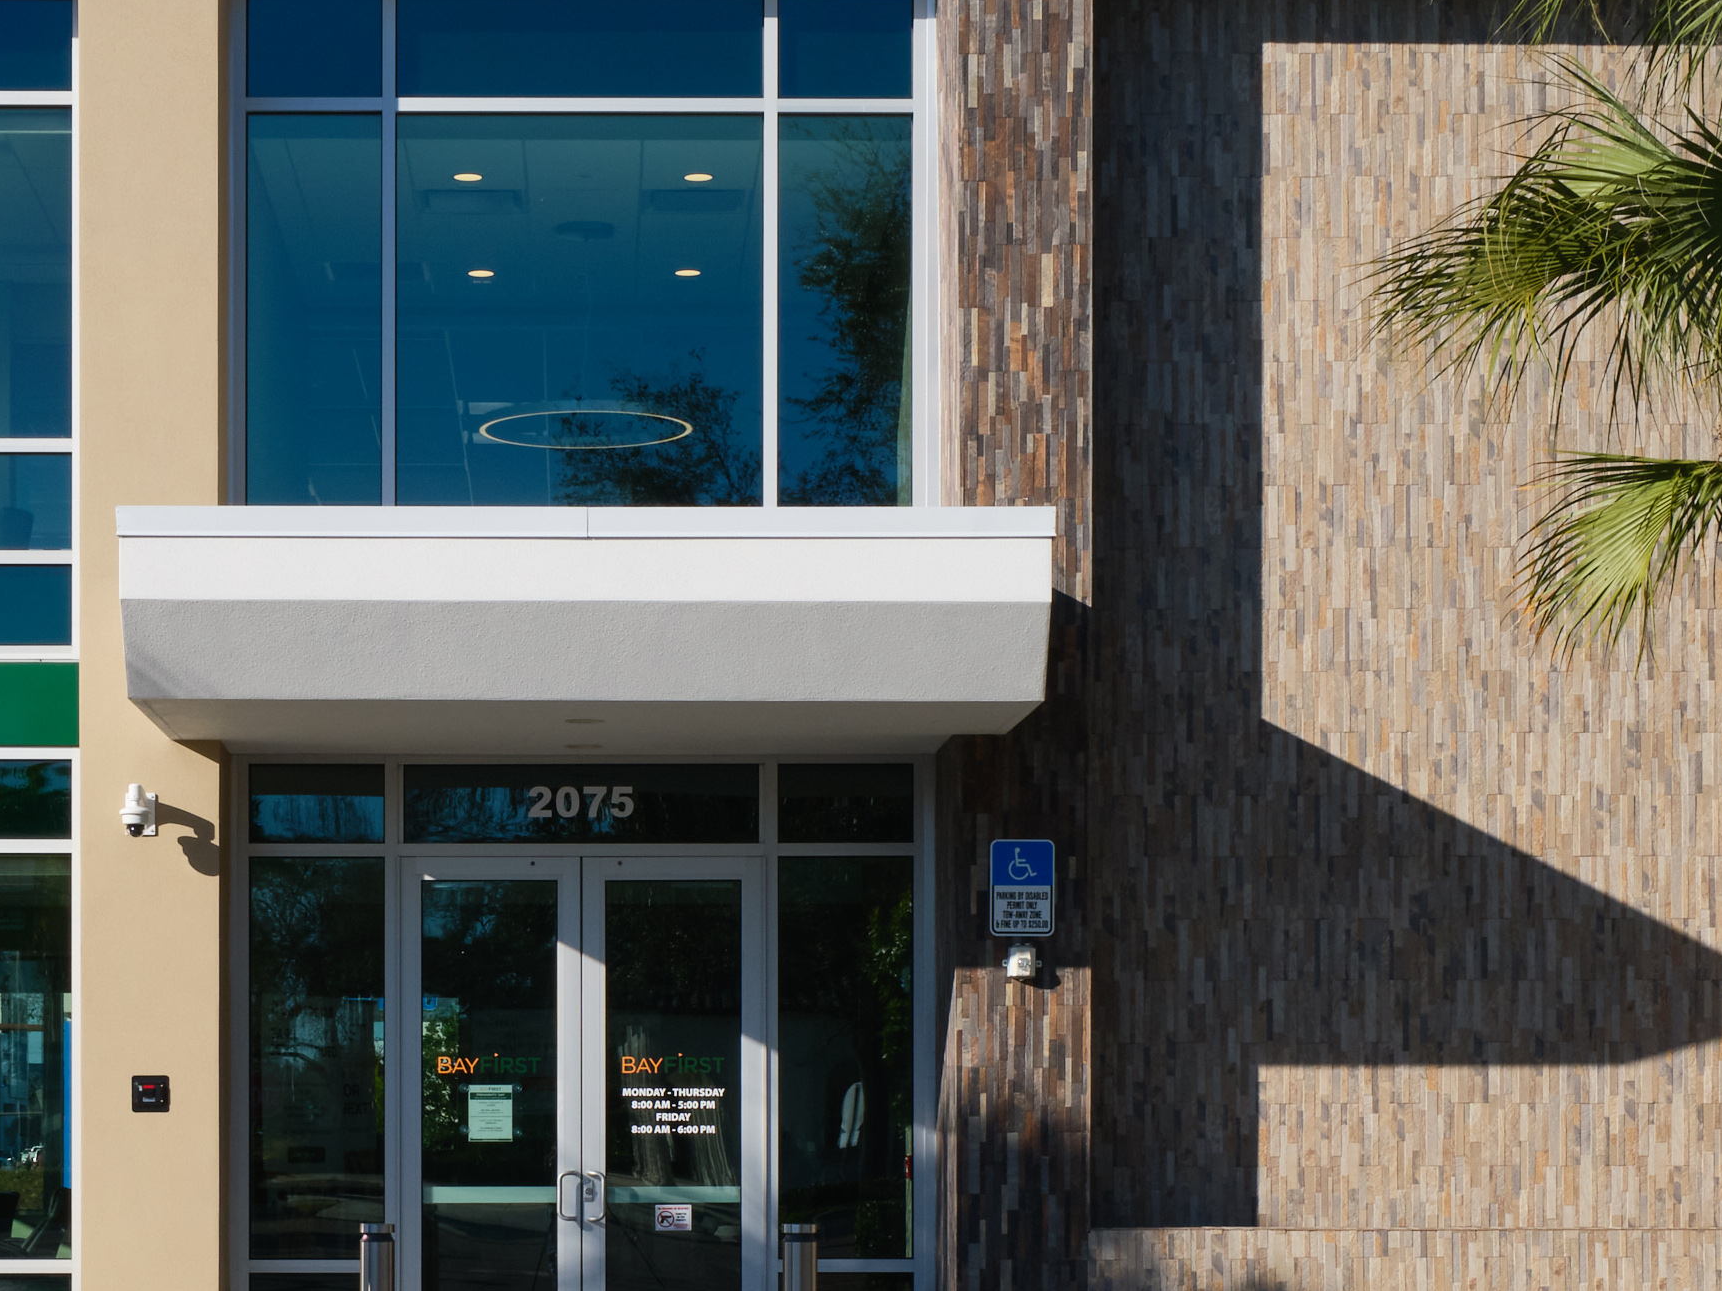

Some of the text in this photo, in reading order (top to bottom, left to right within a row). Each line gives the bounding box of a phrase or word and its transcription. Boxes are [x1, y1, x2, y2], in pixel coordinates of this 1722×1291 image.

[528, 786, 634, 818] 2075
[996, 892, 1048, 900] PARKING BY DISABLED
[1007, 901, 1037, 909] PERMIT ONLY
[1003, 911, 1042, 919] TOW-AWAY ZONE
[1001, 920, 1012, 928] FINE
[1013, 920, 1020, 928] UP
[1021, 920, 1027, 928] TO
[1028, 920, 1048, 928] $250.00
[437, 1053, 541, 1074] BAYFIRST
[621, 1053, 725, 1074] BAYFIRST
[622, 1088, 666, 1097] MONDAY
[672, 1088, 725, 1097] THURSDAY
[631, 1100, 653, 1109] 8:00
[653, 1100, 671, 1109] AM
[677, 1100, 699, 1109] 5:00
[700, 1100, 716, 1109] PM
[656, 1113, 691, 1122] FRIDAY
[631, 1125, 653, 1134] 8:00
[653, 1125, 671, 1134] AM
[677, 1125, 699, 1134] 6:00
[700, 1125, 716, 1134] PM
